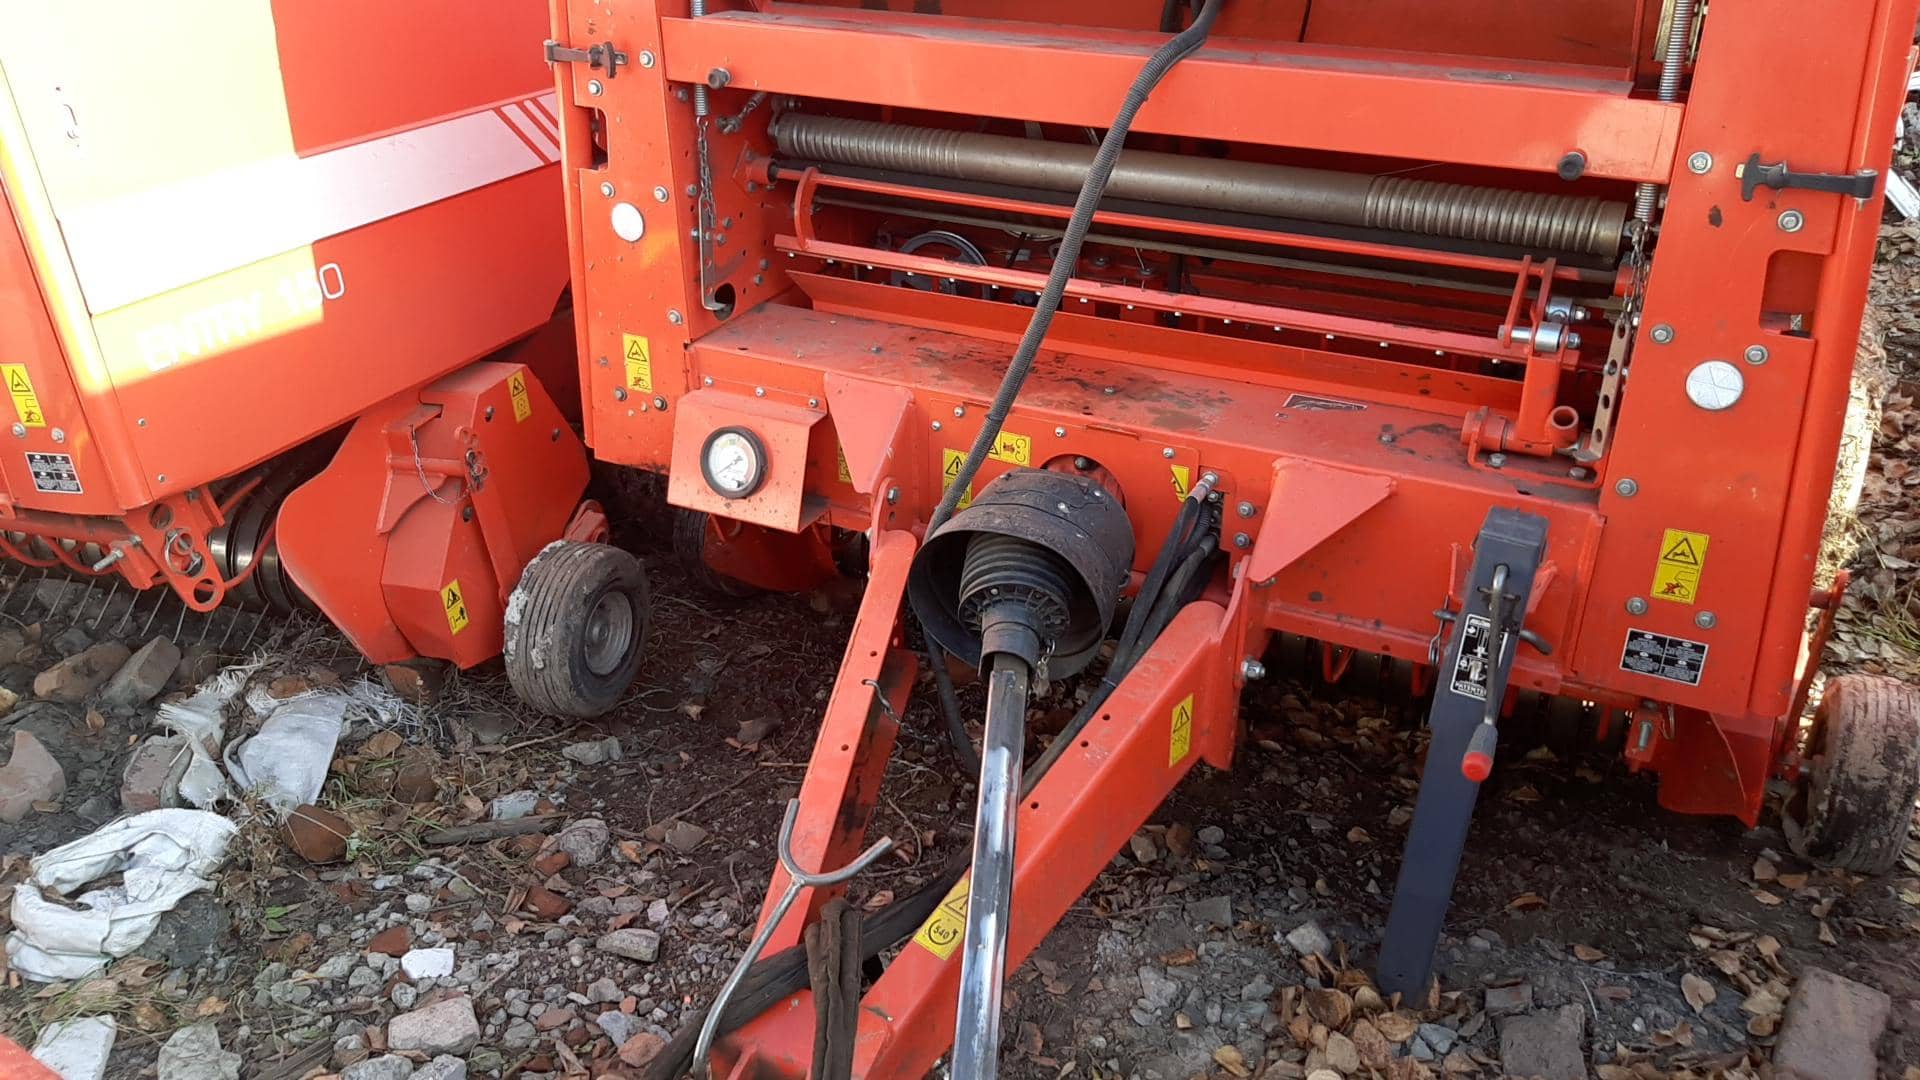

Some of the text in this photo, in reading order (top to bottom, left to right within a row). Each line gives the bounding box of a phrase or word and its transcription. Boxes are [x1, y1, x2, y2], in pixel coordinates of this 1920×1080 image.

[137, 263, 345, 371] ENTRY 150
[933, 924, 950, 939] 540
